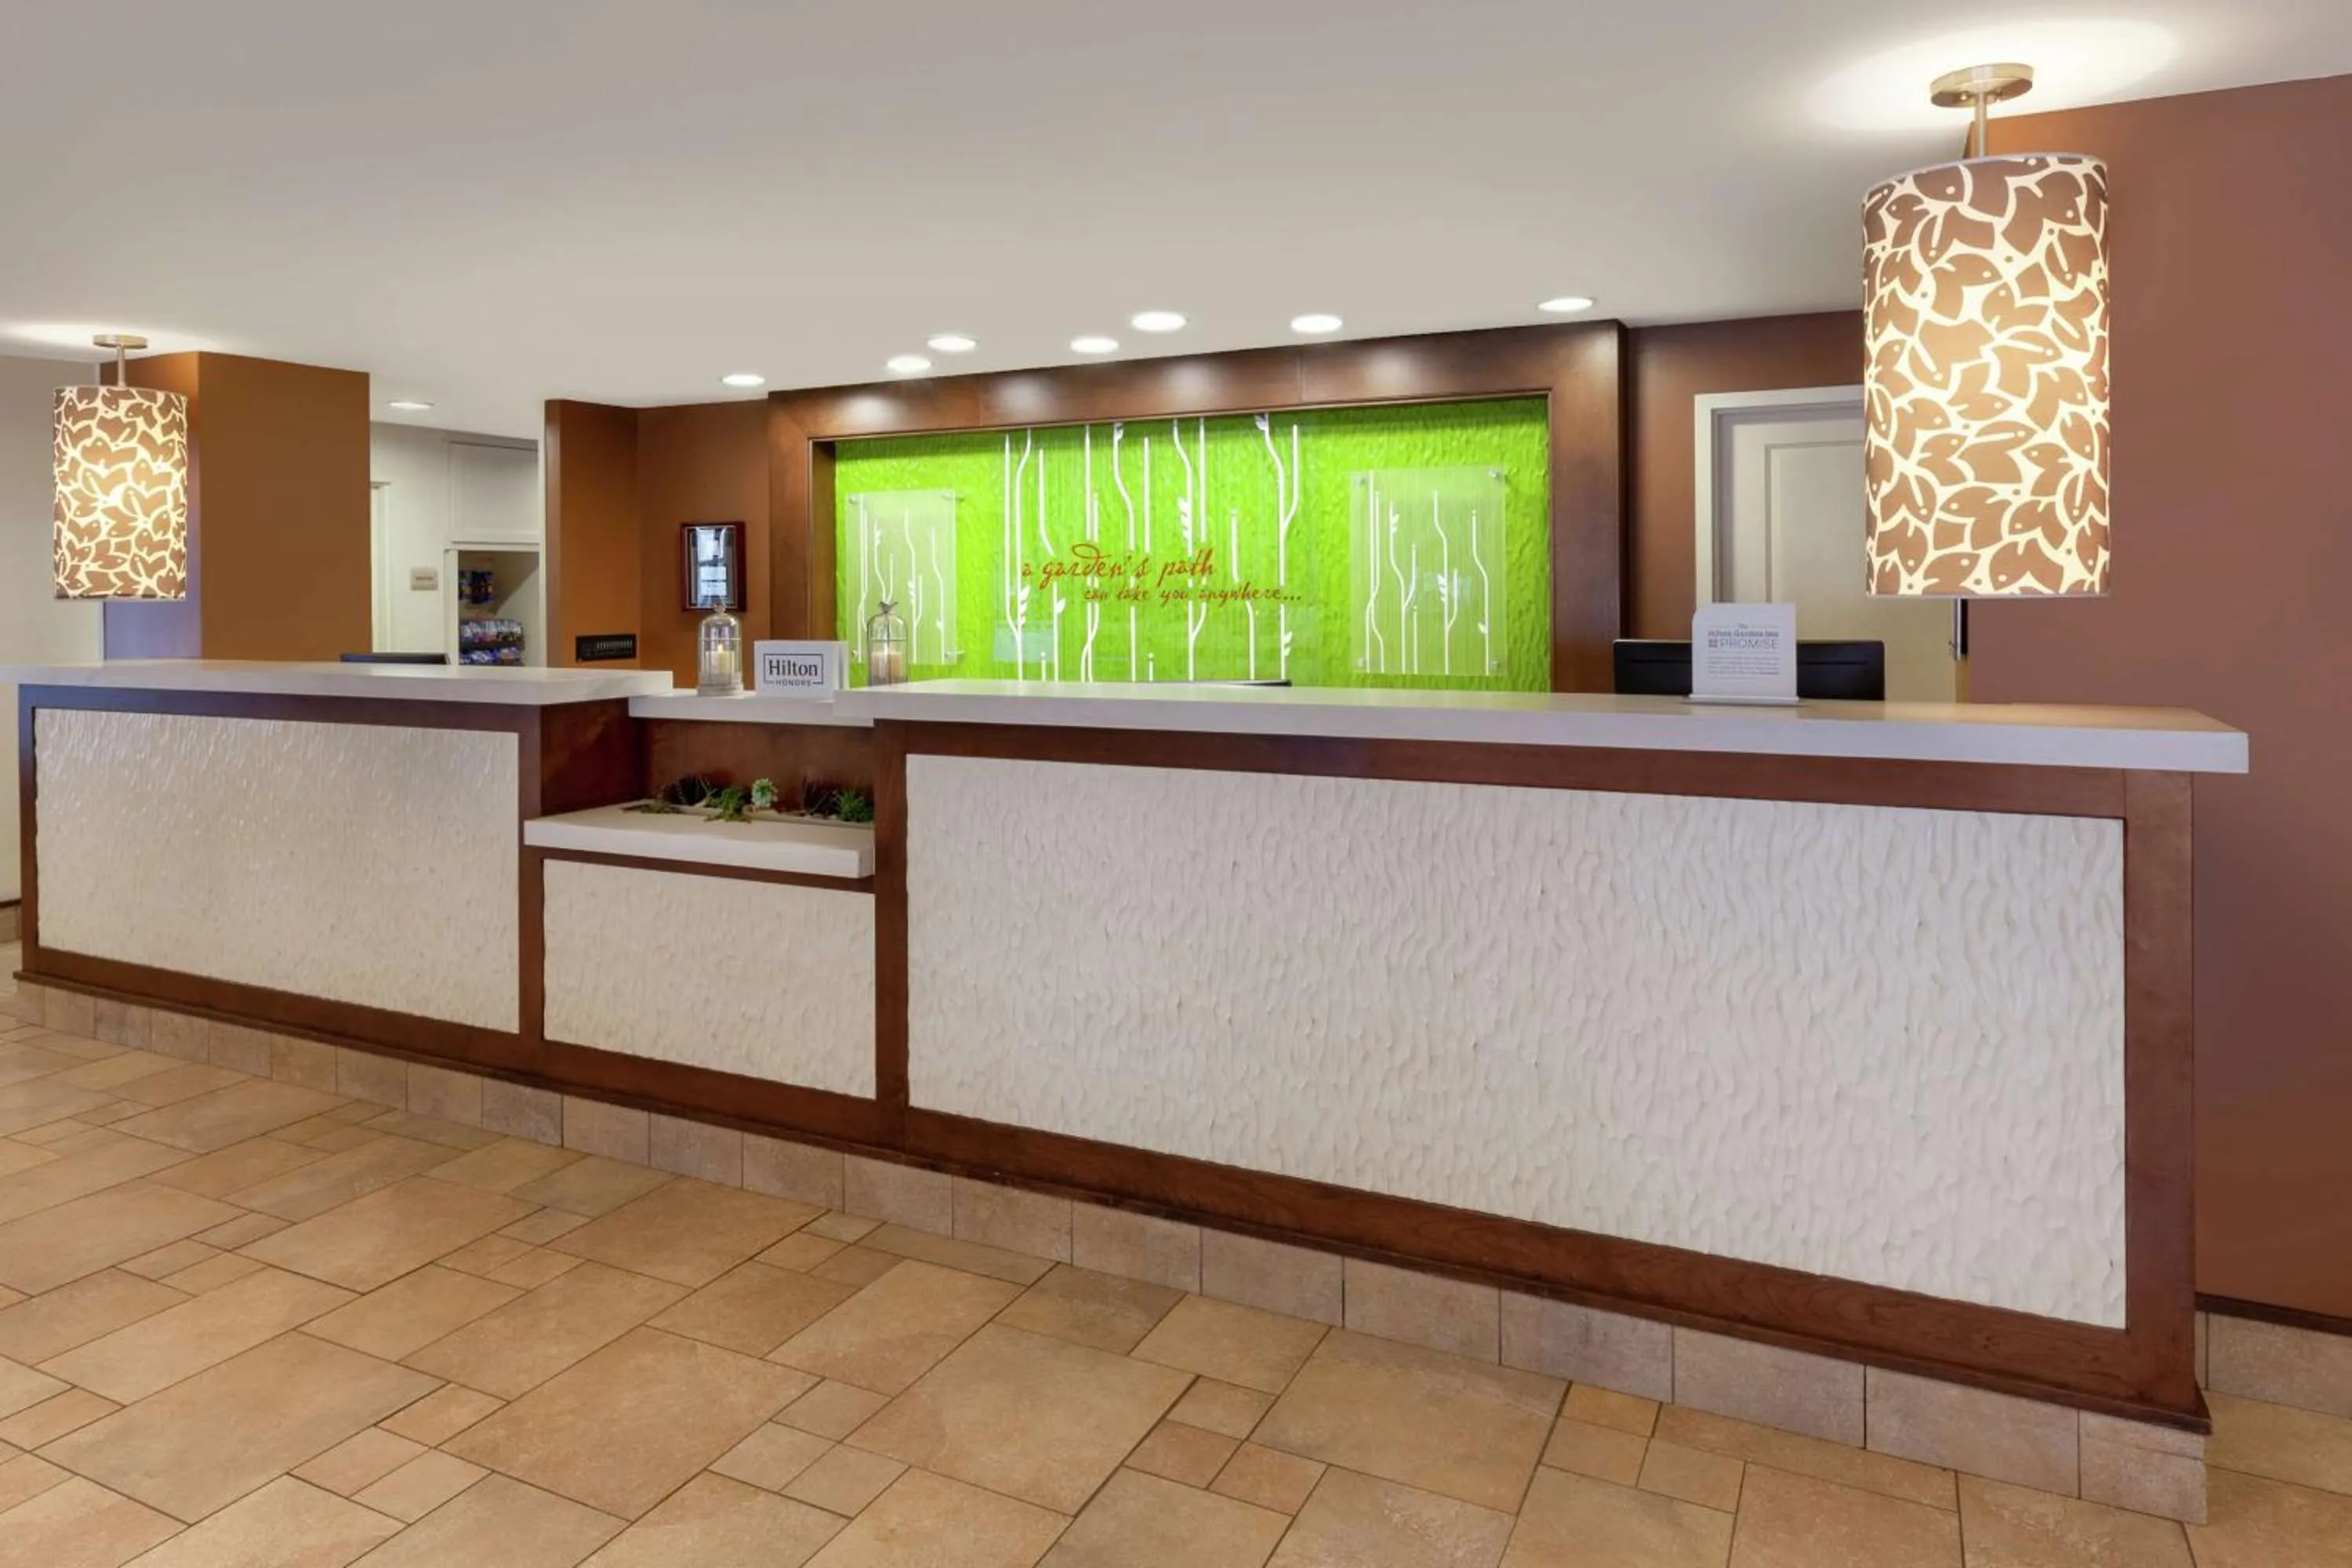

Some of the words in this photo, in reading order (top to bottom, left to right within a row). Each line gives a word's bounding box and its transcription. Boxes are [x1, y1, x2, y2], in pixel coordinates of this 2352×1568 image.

[1022, 563, 1032, 577] a
[1040, 543, 1150, 590] garden's
[1156, 548, 1214, 587] path
[1084, 590, 1108, 601] can
[1116, 584, 1149, 601] take
[1160, 590, 1189, 608] you
[1720, 639, 1779, 650] PROMISE
[768, 659, 818, 677] Hilton
[775, 679, 811, 688] HONORS
